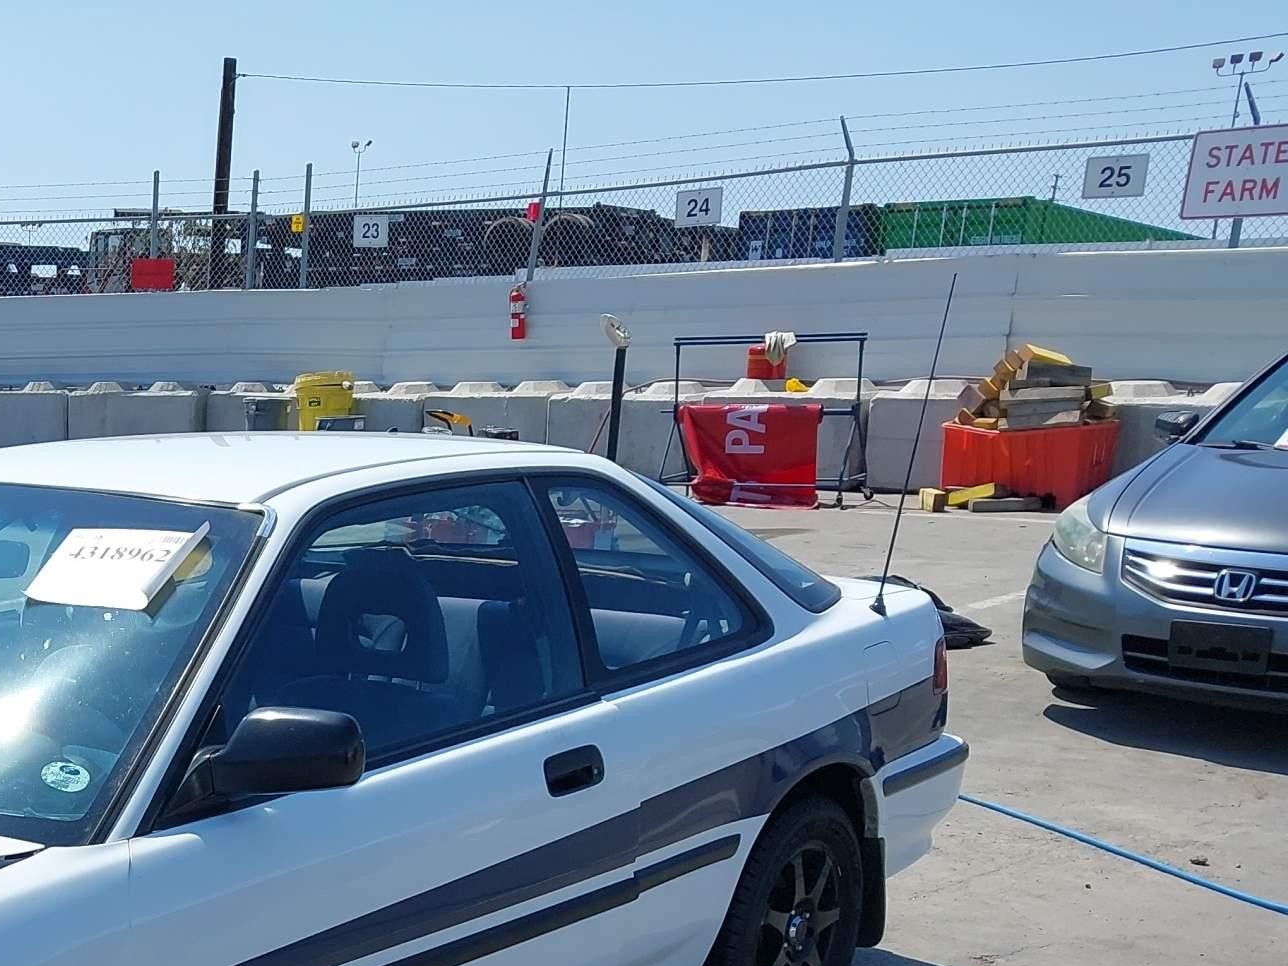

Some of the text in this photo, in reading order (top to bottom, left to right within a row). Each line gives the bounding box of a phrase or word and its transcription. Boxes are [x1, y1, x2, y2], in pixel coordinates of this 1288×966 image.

[1206, 141, 1288, 168] STATE
[1098, 165, 1132, 188] 25
[1202, 177, 1280, 203] FARM
[686, 198, 710, 217] 24
[362, 222, 380, 239] 23
